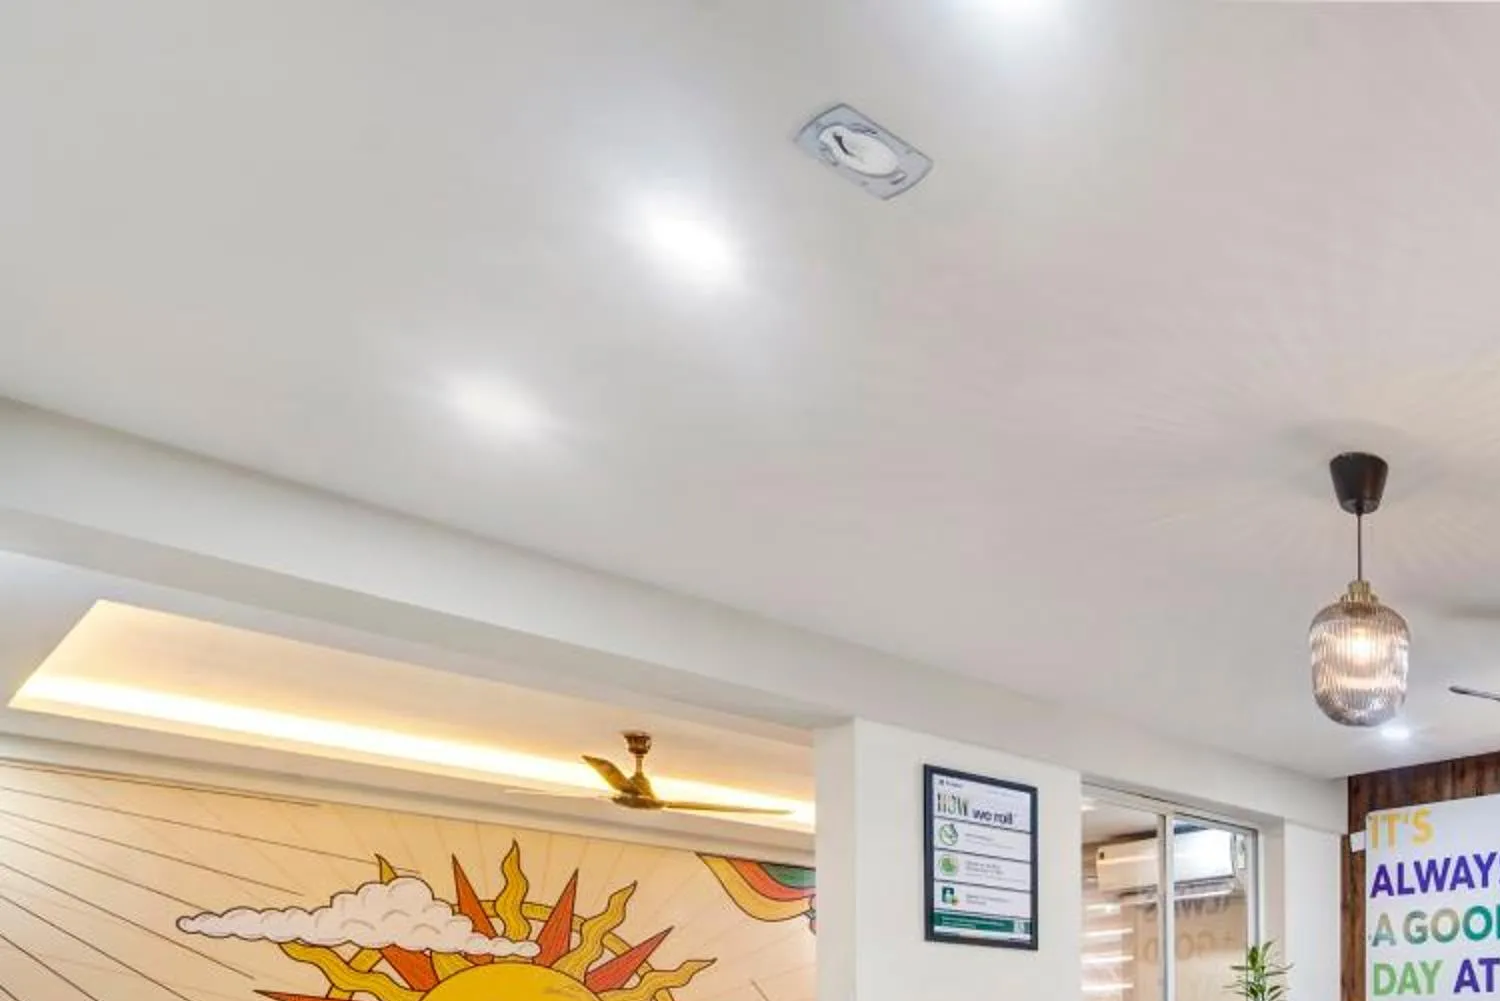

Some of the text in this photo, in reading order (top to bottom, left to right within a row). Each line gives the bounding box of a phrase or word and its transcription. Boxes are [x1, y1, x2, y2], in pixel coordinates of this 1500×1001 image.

[1369, 808, 1435, 849] IT'S
[1372, 912, 1396, 947] A
[1373, 959, 1443, 996] DAY
